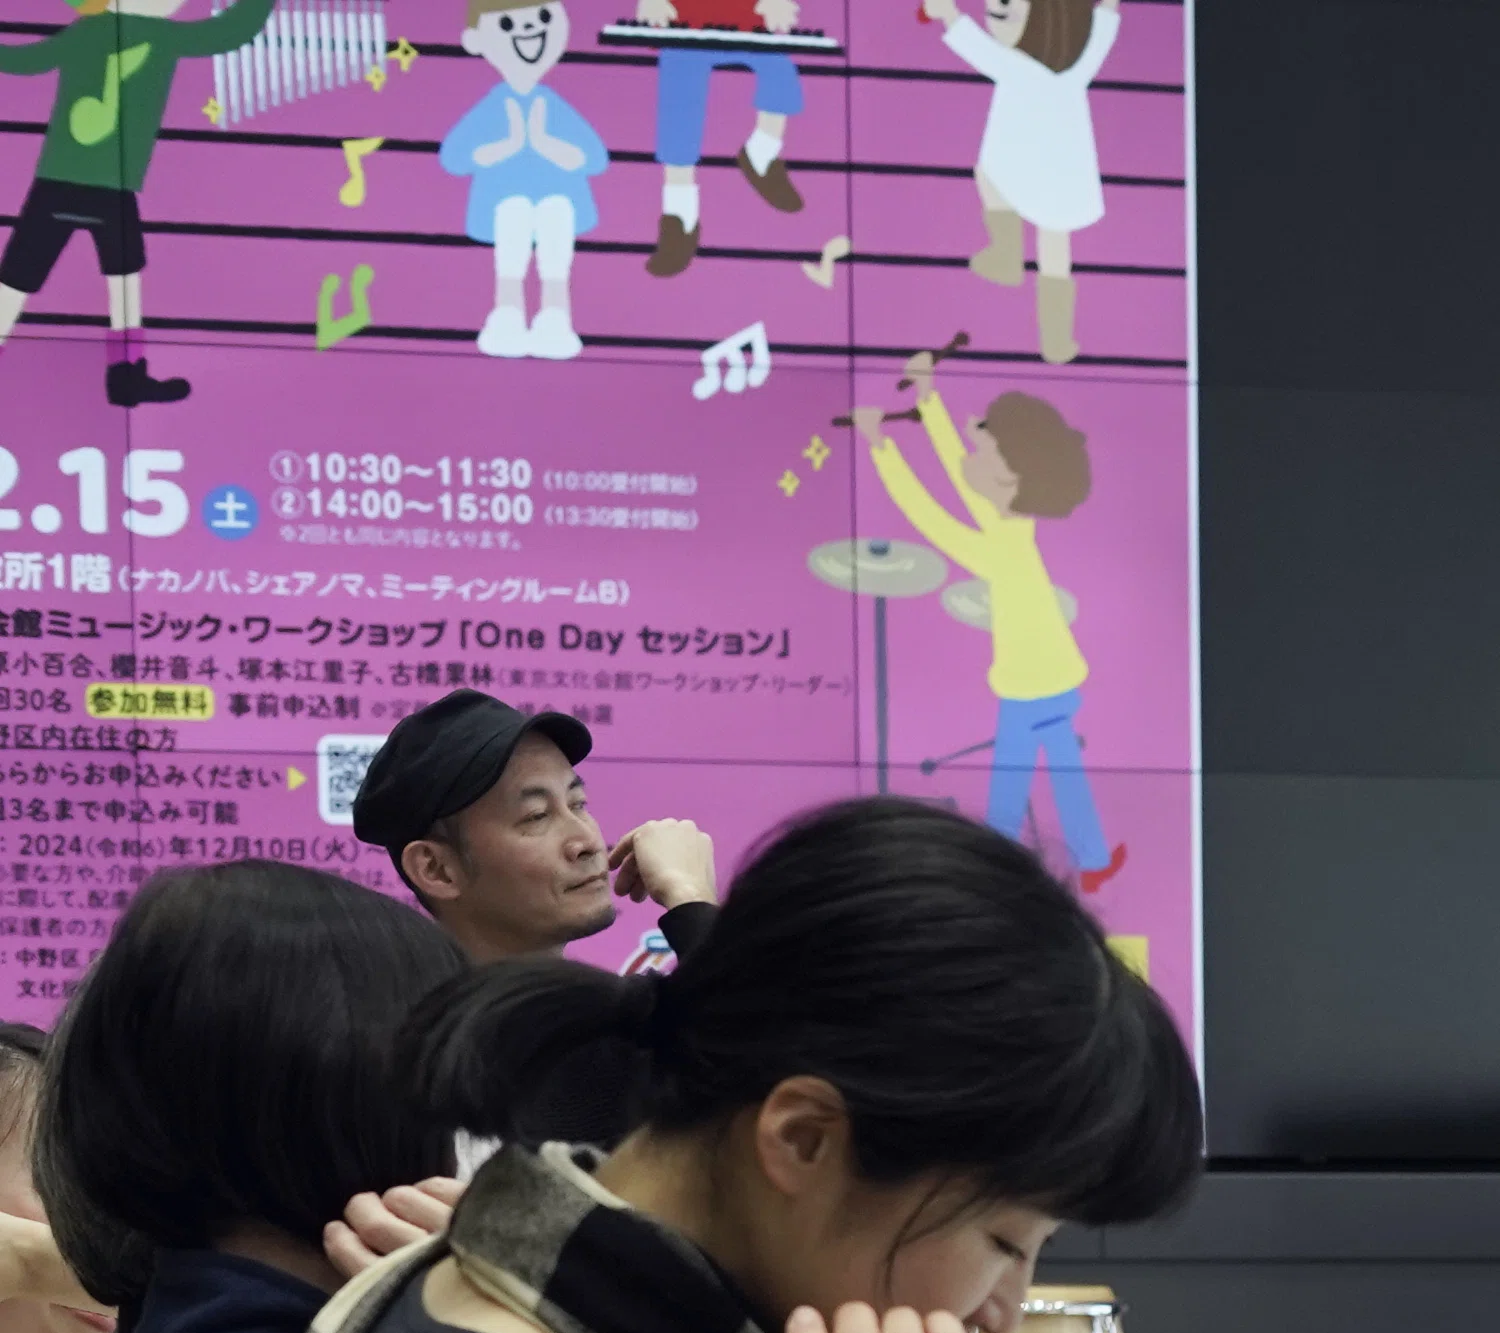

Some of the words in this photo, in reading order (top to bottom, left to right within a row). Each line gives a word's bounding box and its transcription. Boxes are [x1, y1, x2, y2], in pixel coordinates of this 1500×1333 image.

[559, 624, 626, 657] Day
[90, 688, 208, 717] 参加無料
